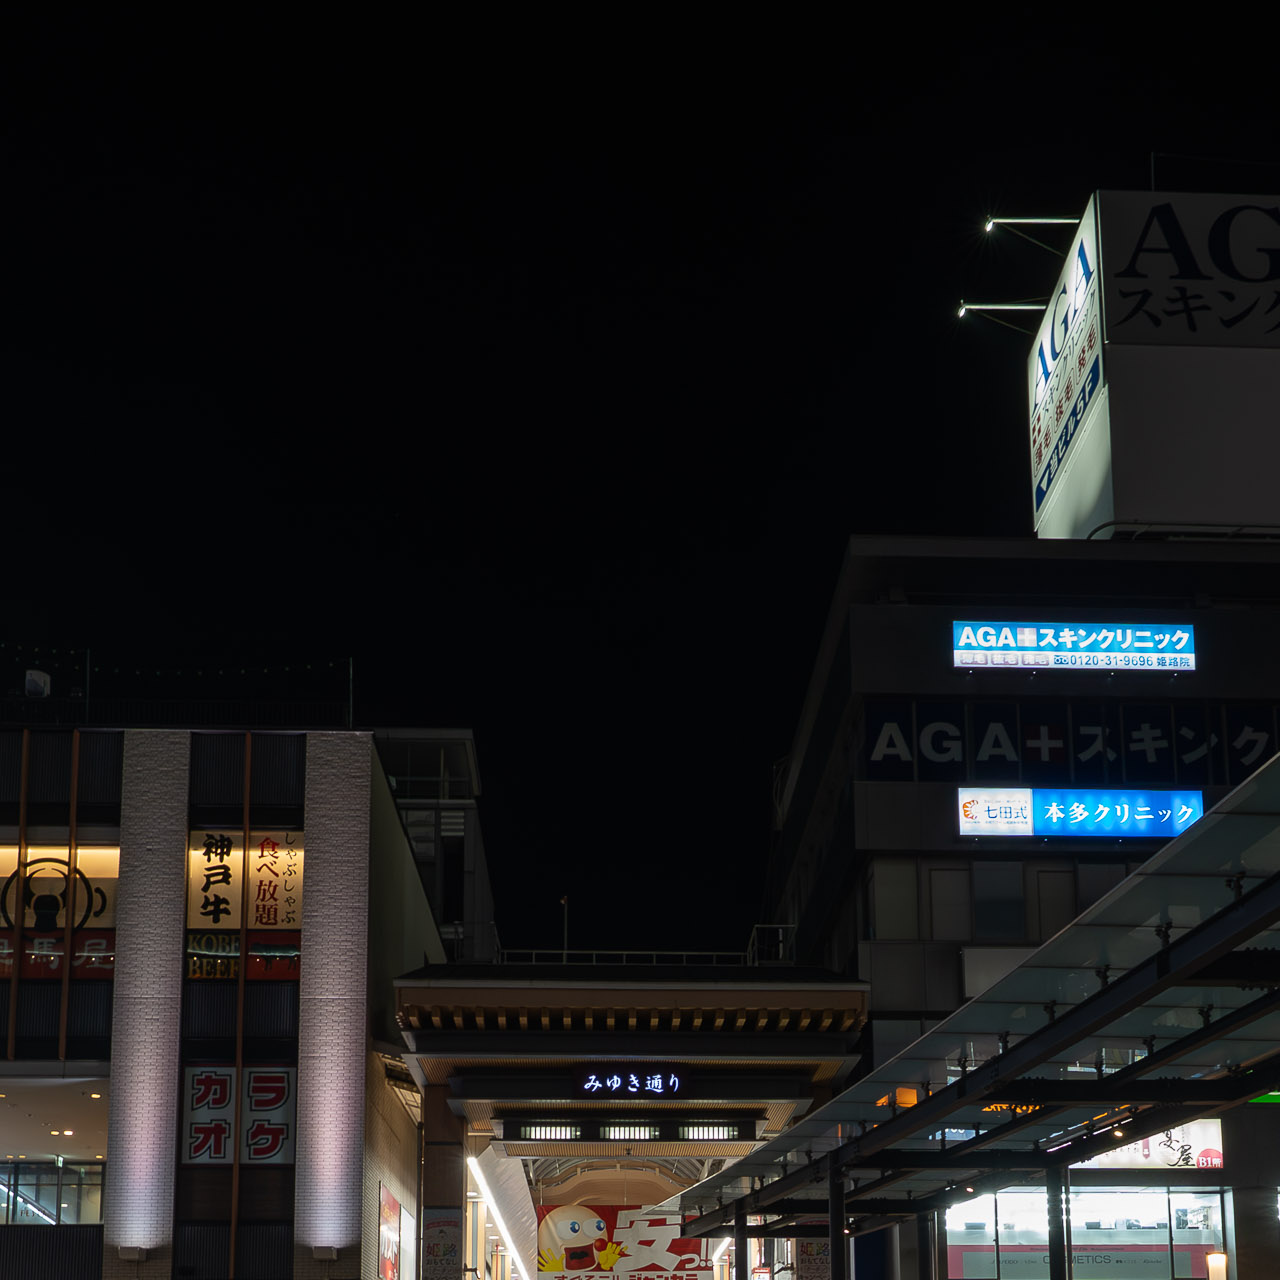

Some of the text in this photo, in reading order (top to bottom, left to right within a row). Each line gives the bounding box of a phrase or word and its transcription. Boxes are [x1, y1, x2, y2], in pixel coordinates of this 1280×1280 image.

[958, 626, 1016, 647] AGA
[1039, 627, 1190, 650] スキンクリニック
[1070, 655, 1153, 667] 0120-31-9696
[869, 721, 1018, 763] AGA
[984, 805, 1028, 819] 七田式
[1044, 802, 1194, 823] 本多クリニック
[199, 833, 234, 924] 神戸牛
[253, 837, 281, 926] 食べ放題
[281, 832, 297, 924] しゃぶしゃぶ
[189, 934, 241, 954] KOBE
[187, 957, 241, 980] BEEF
[583, 1073, 680, 1093] みゆき通り
[425, 1243, 458, 1257] 姫路
